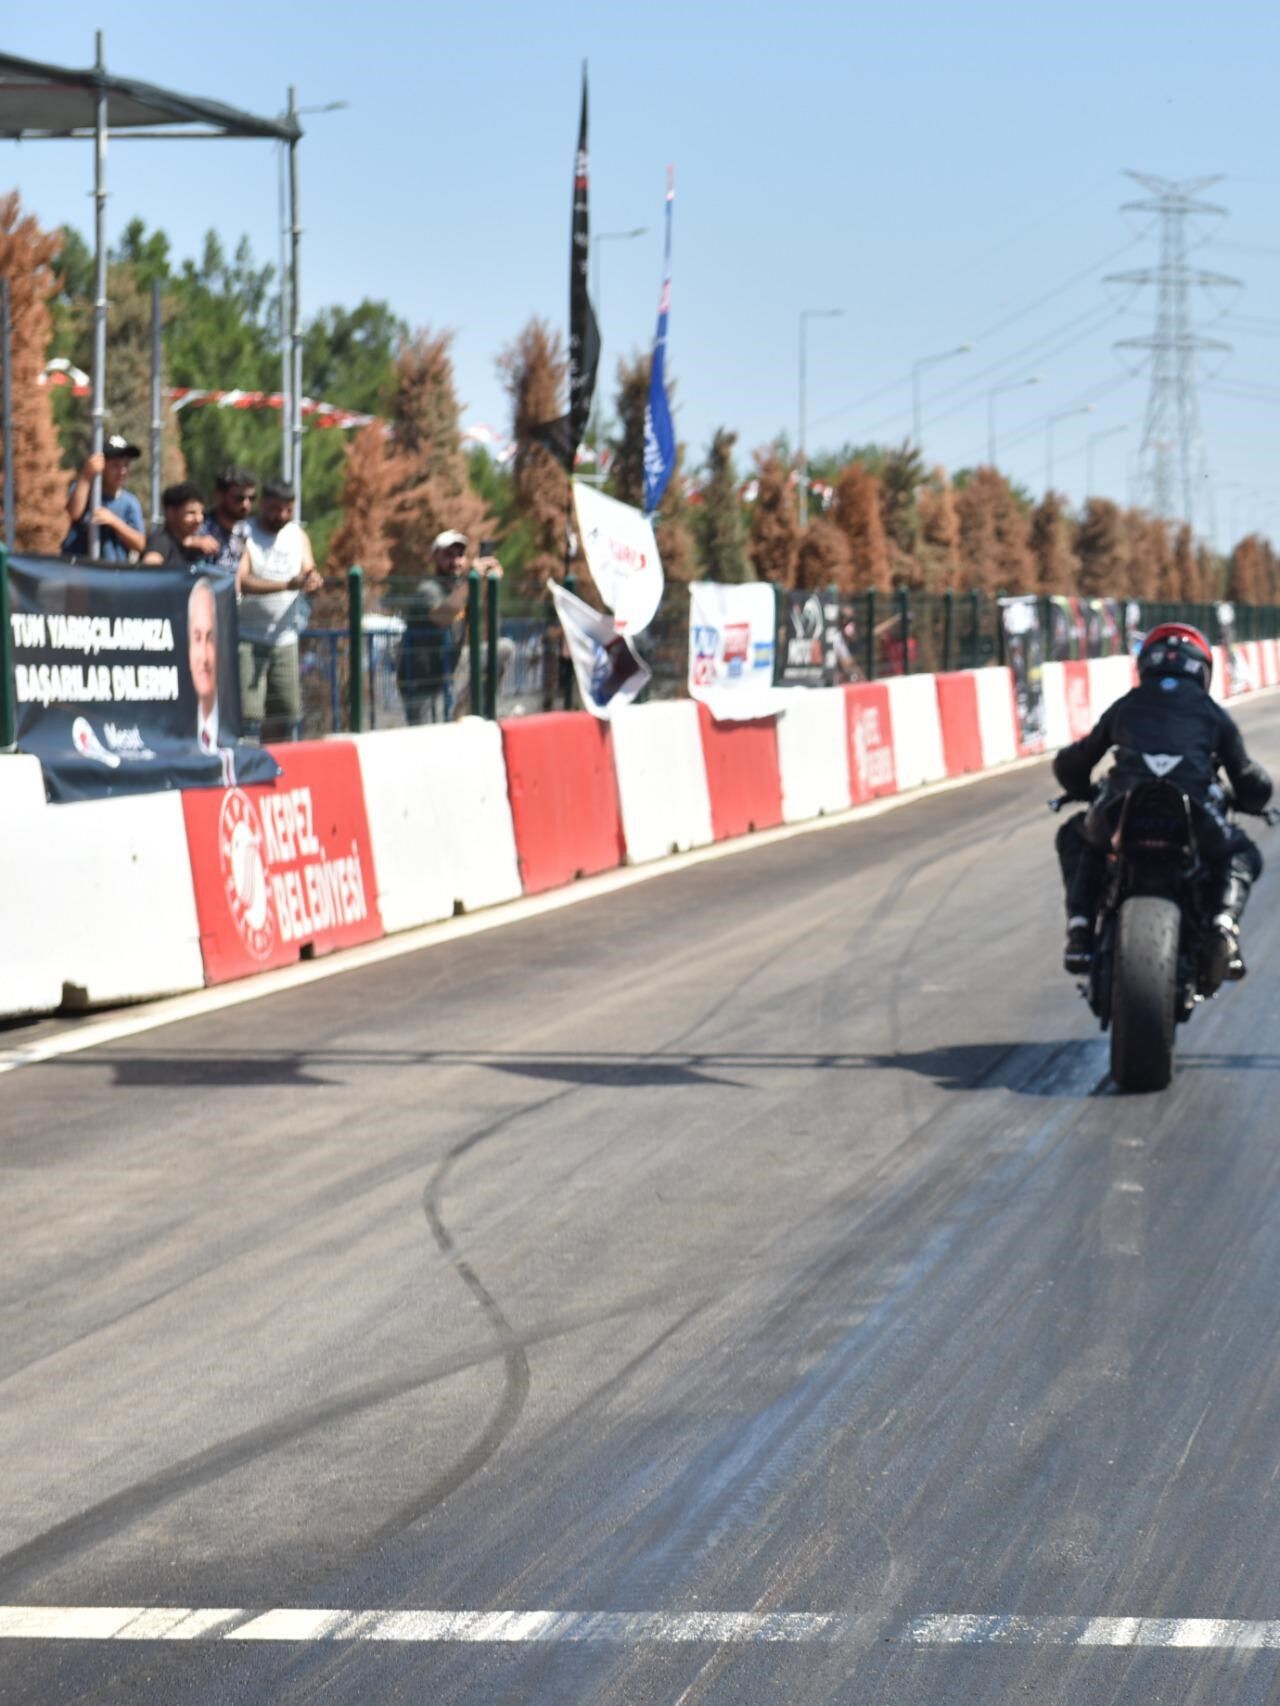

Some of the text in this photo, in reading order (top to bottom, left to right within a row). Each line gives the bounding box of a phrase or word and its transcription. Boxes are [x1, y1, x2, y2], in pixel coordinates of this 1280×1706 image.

[15, 664, 112, 708] BAŞARILAR
[259, 786, 319, 865] KEPEZ
[271, 838, 368, 943] BELEDİYESİ
